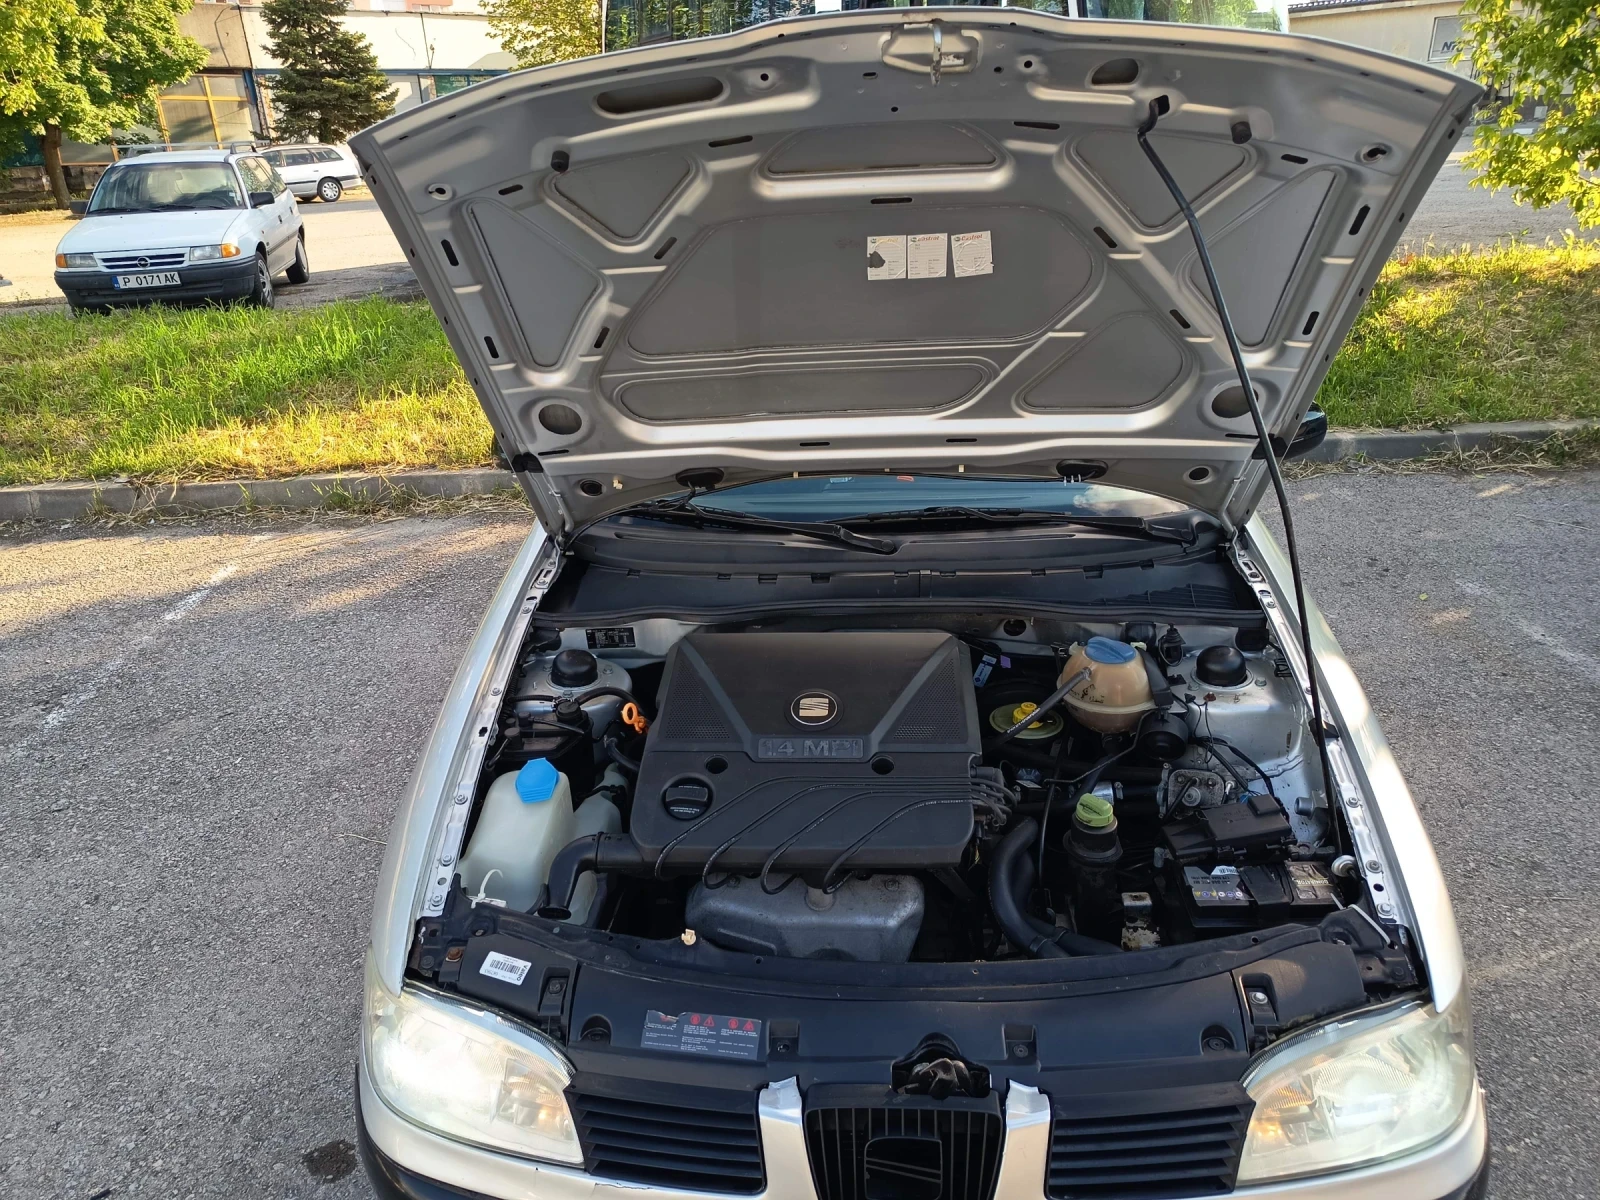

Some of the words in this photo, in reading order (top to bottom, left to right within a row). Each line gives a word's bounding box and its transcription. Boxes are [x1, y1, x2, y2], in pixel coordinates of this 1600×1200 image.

[961, 233, 983, 241] Castrol
[122, 276, 131, 287] P
[136, 274, 162, 286] 0171
[164, 272, 178, 284] AK
[763, 740, 795, 757] 1.4
[803, 739, 858, 757] MPI
